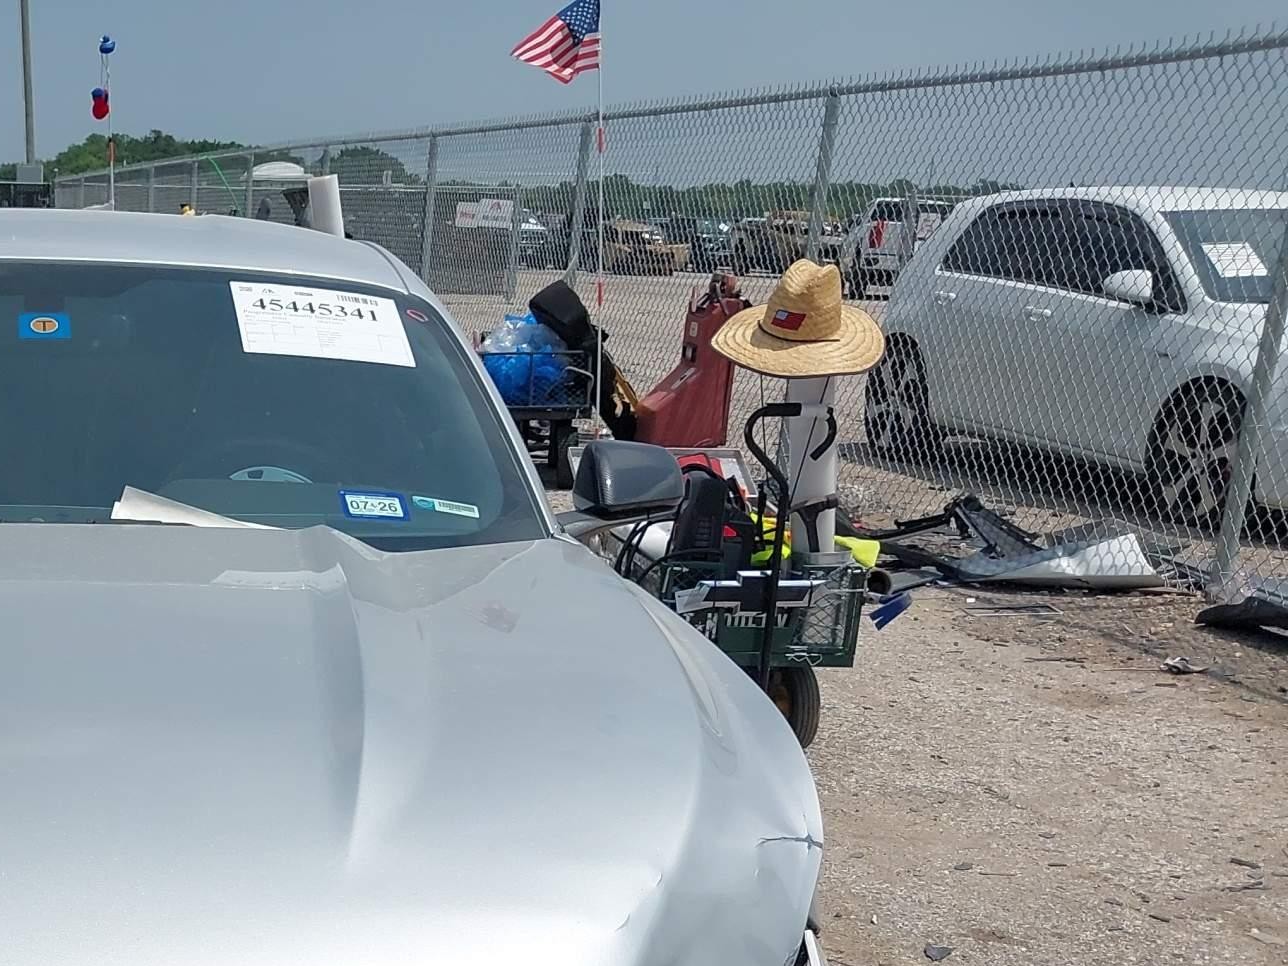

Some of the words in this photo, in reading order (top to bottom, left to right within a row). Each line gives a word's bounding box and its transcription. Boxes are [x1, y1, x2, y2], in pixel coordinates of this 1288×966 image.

[252, 298, 379, 322] 45445341
[350, 500, 369, 511] 07
[378, 501, 398, 513] 26
